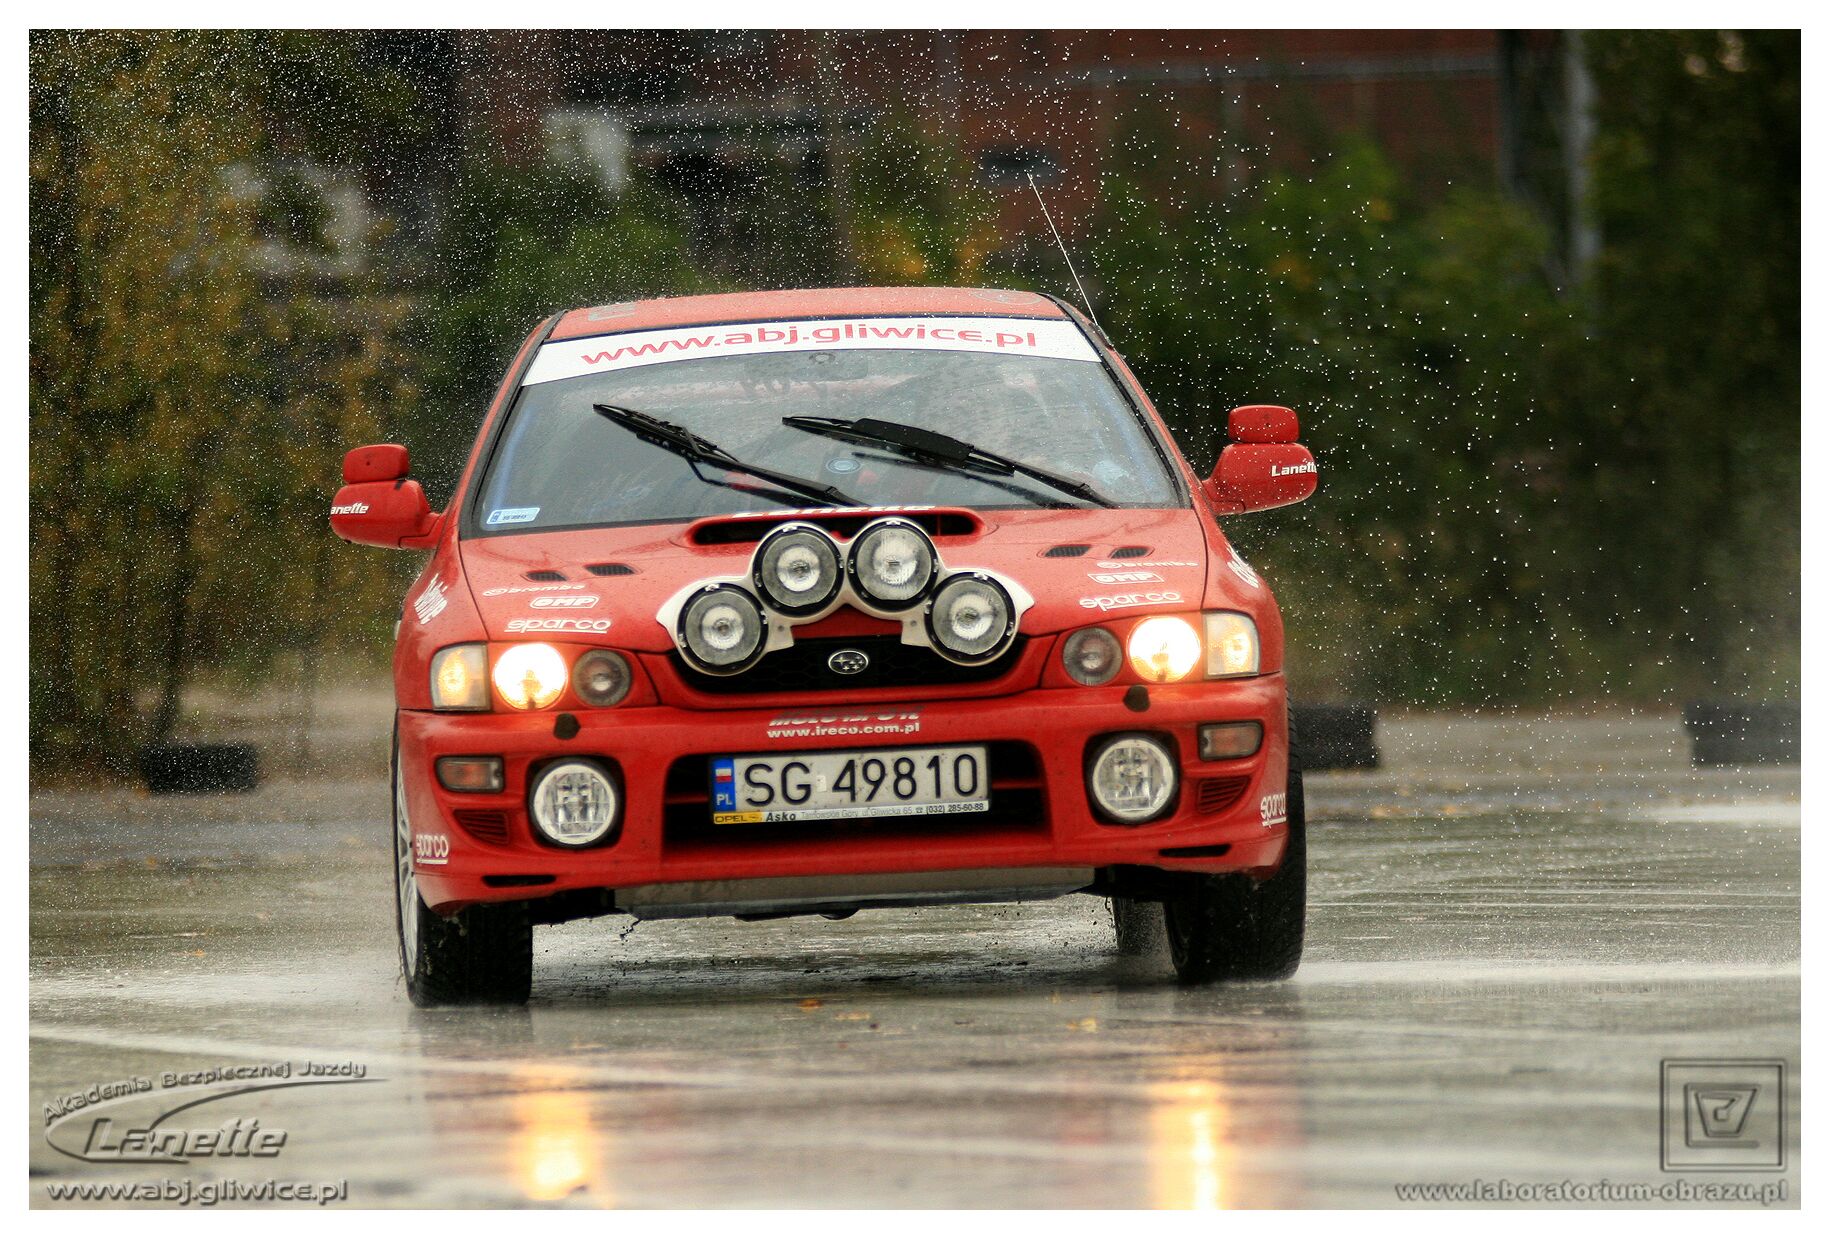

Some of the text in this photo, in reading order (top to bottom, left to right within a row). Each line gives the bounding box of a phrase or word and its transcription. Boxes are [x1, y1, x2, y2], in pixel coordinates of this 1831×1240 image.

[581, 323, 1037, 365] www.abj.gliwice.pl
[330, 502, 369, 515] anette
[1079, 592, 1181, 612] sparco
[507, 618, 612, 633] sparco
[767, 722, 920, 739] www.ireco.com.pl
[744, 753, 978, 807] SG 49810
[716, 793, 733, 806] PL
[715, 815, 746, 823] OPEL
[766, 811, 797, 822] Asko
